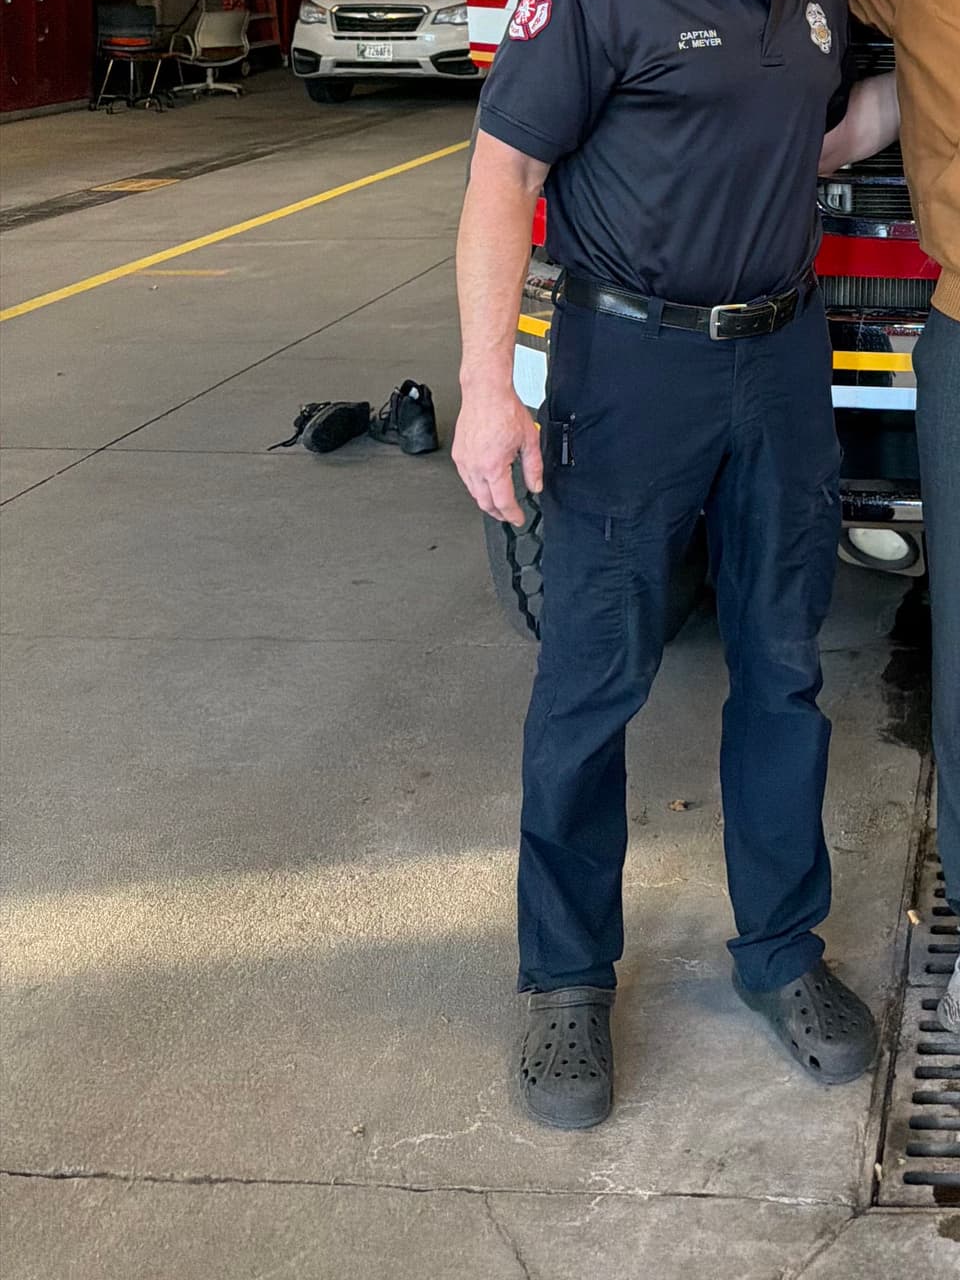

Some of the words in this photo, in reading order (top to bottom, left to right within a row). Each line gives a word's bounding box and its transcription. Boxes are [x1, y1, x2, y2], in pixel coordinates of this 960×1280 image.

[680, 30, 717, 41] CAPTAIN
[678, 40, 689, 50] K.
[692, 38, 722, 48] MEYER
